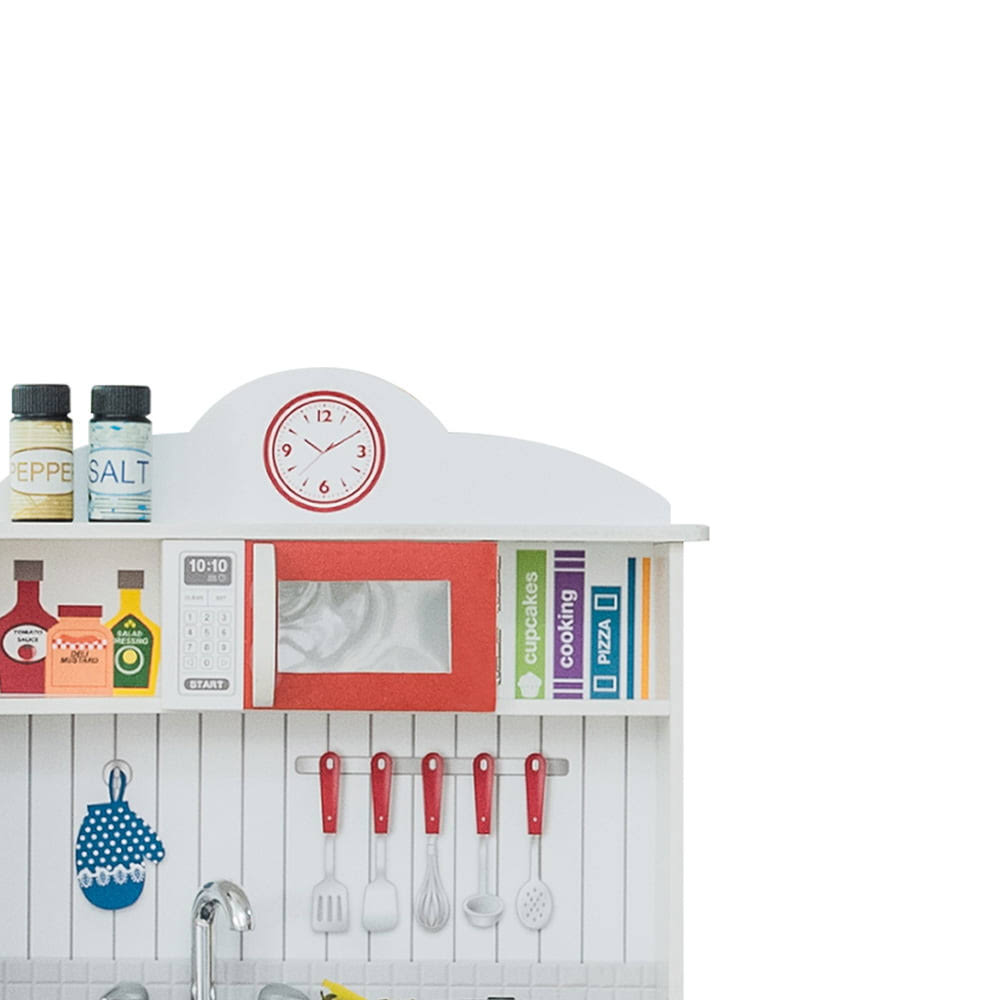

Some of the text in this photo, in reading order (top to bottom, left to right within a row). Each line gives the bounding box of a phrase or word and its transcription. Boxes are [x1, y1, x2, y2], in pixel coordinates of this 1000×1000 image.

[317, 409, 332, 422] 12
[281, 443, 292, 457] 9
[356, 444, 366, 458] 3
[10, 461, 73, 482] PEPPE
[88, 459, 149, 484] SALT
[319, 480, 330, 494] 6
[189, 558, 228, 573] 10:10
[522, 571, 541, 664] cupcakes
[557, 589, 578, 669] cooking
[598, 619, 611, 665] PIZZA
[189, 680, 224, 689] START
